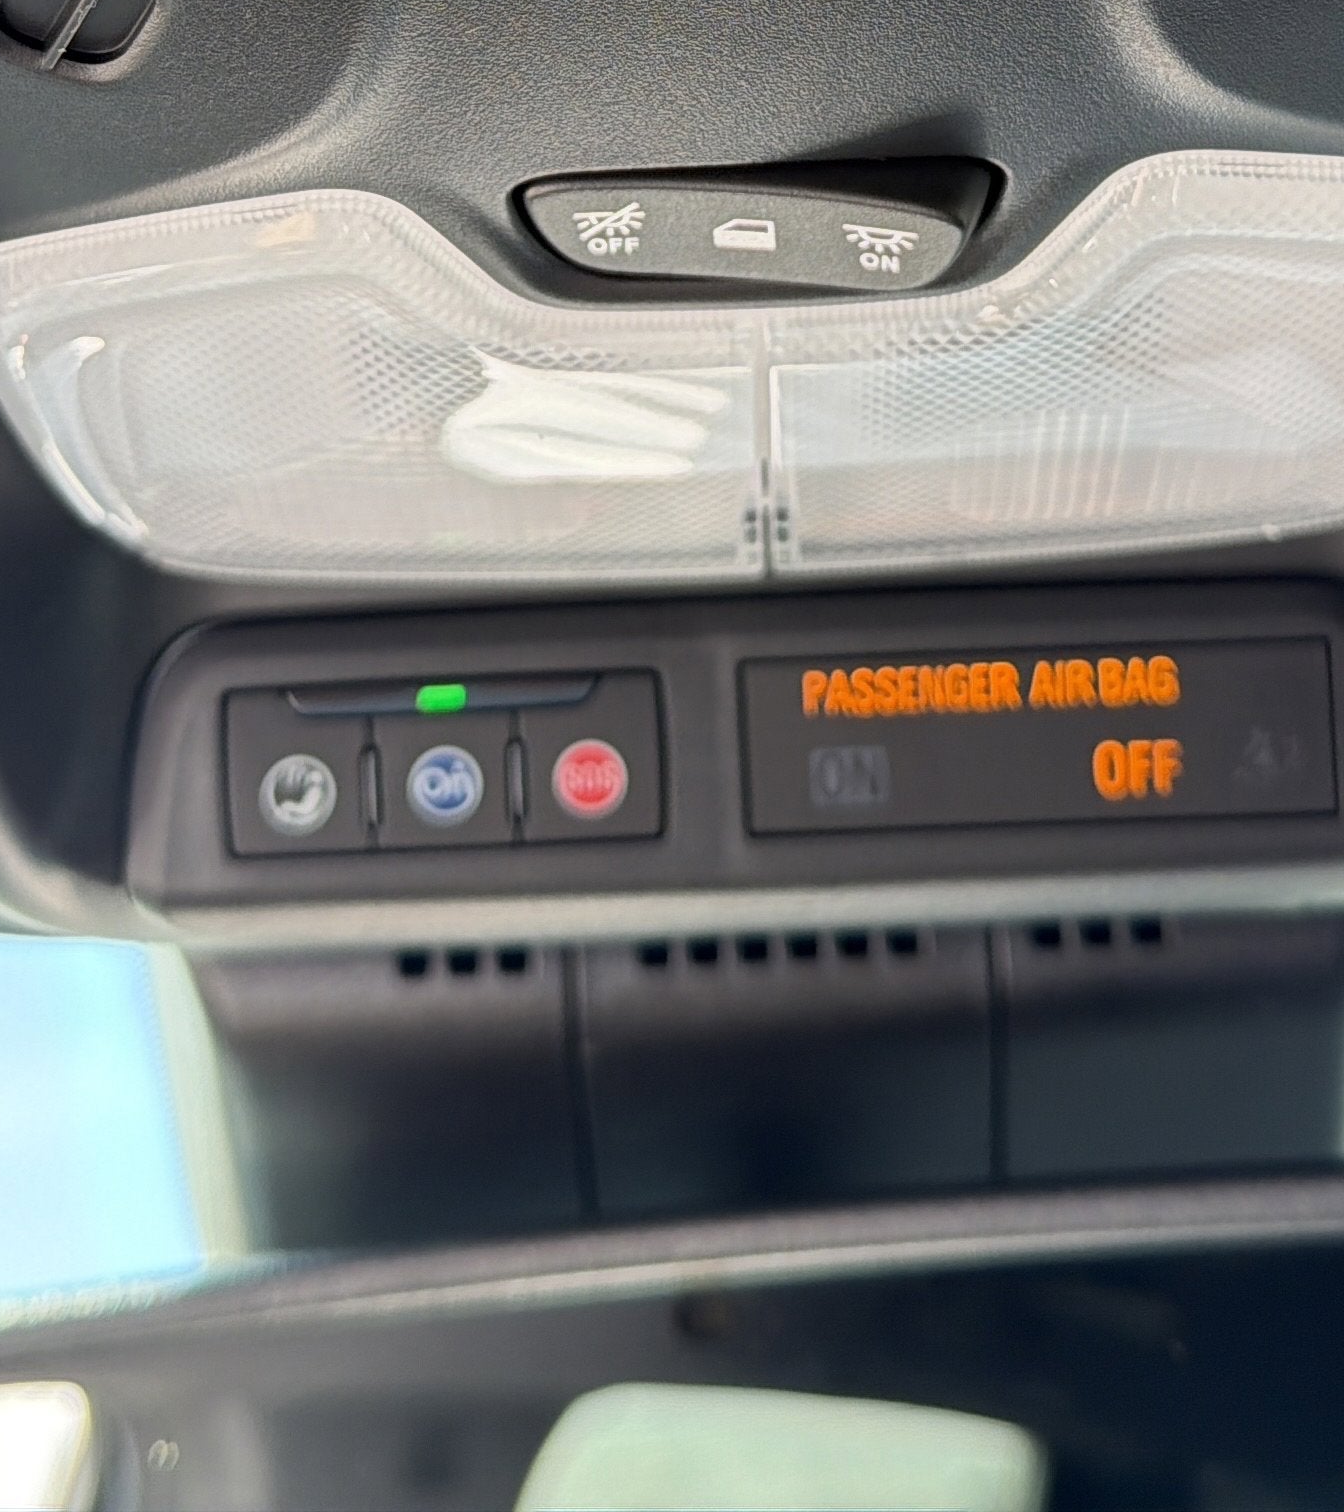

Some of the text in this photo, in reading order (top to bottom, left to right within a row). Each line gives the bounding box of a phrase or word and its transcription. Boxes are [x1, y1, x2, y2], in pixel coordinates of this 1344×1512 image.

[587, 237, 640, 256] OFF
[859, 252, 901, 274] ON
[802, 661, 1023, 717] PASSENGER
[1092, 738, 1183, 801] OFF
